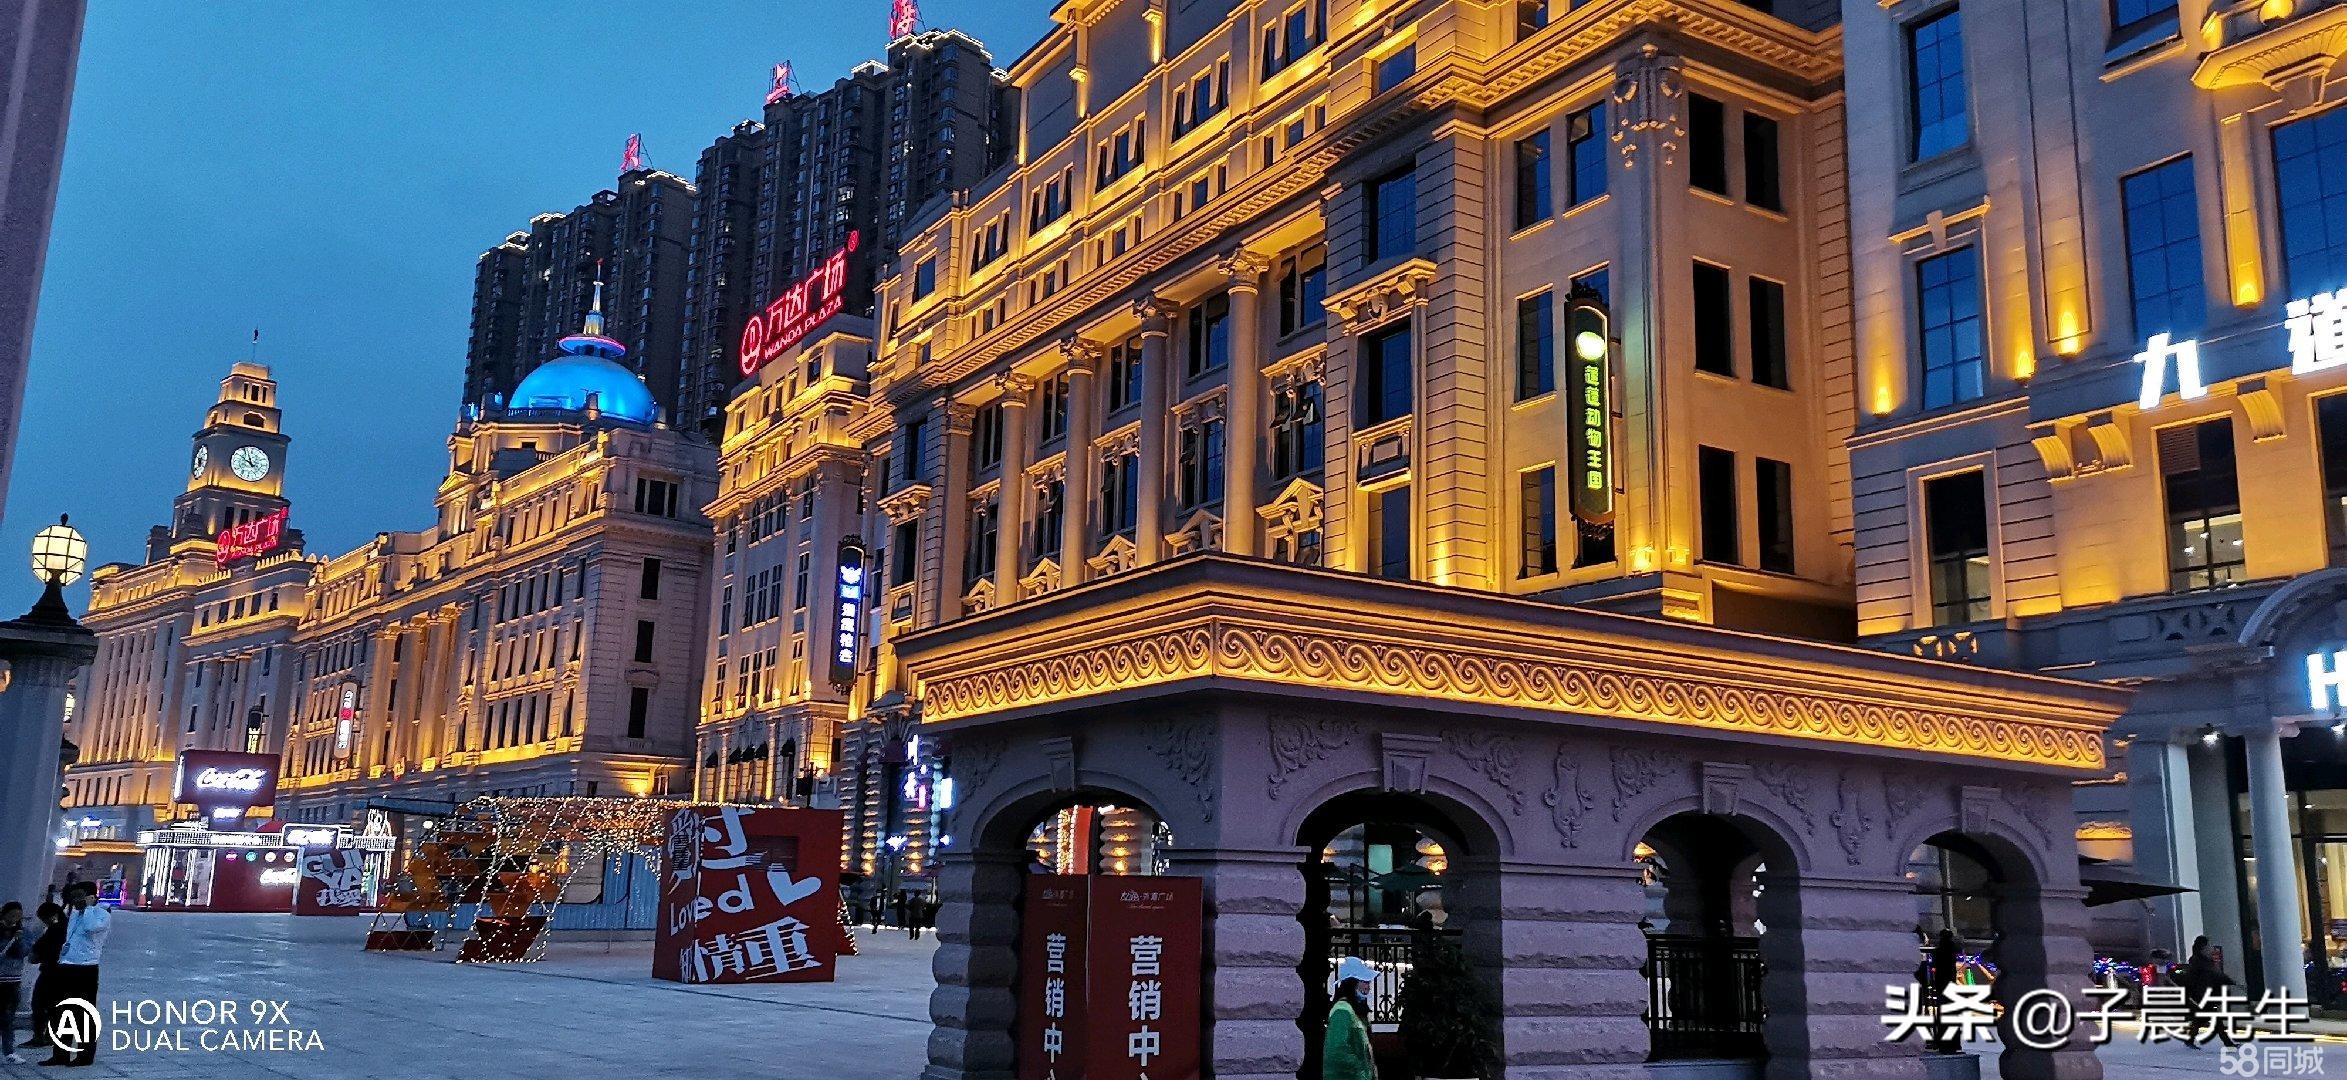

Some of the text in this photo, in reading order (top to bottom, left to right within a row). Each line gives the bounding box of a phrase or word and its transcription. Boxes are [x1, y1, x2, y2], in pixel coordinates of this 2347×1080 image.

[766, 247, 845, 342] 万达广场
[764, 296, 843, 359] WANDA PLAZA
[670, 873, 755, 937] Loved
